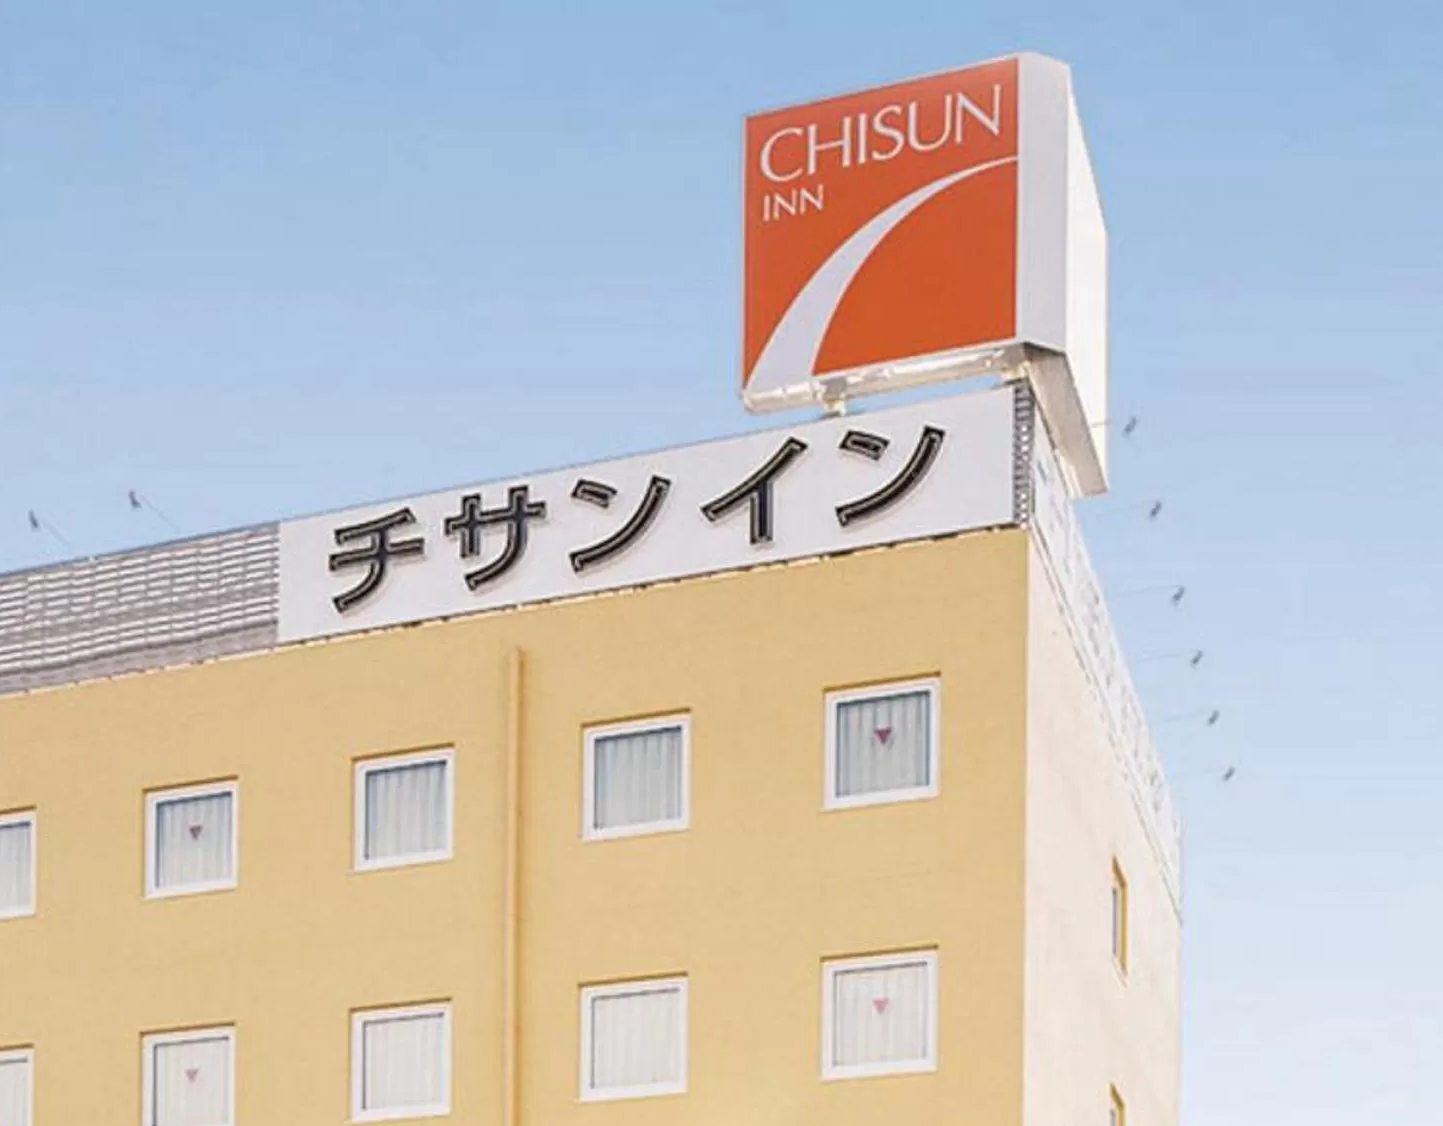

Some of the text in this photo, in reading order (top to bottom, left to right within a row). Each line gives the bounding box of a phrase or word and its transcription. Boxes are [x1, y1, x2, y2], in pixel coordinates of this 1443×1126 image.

[760, 83, 1002, 183] CHISUN
[762, 184, 825, 222] INN
[328, 425, 946, 615] チサンイン
